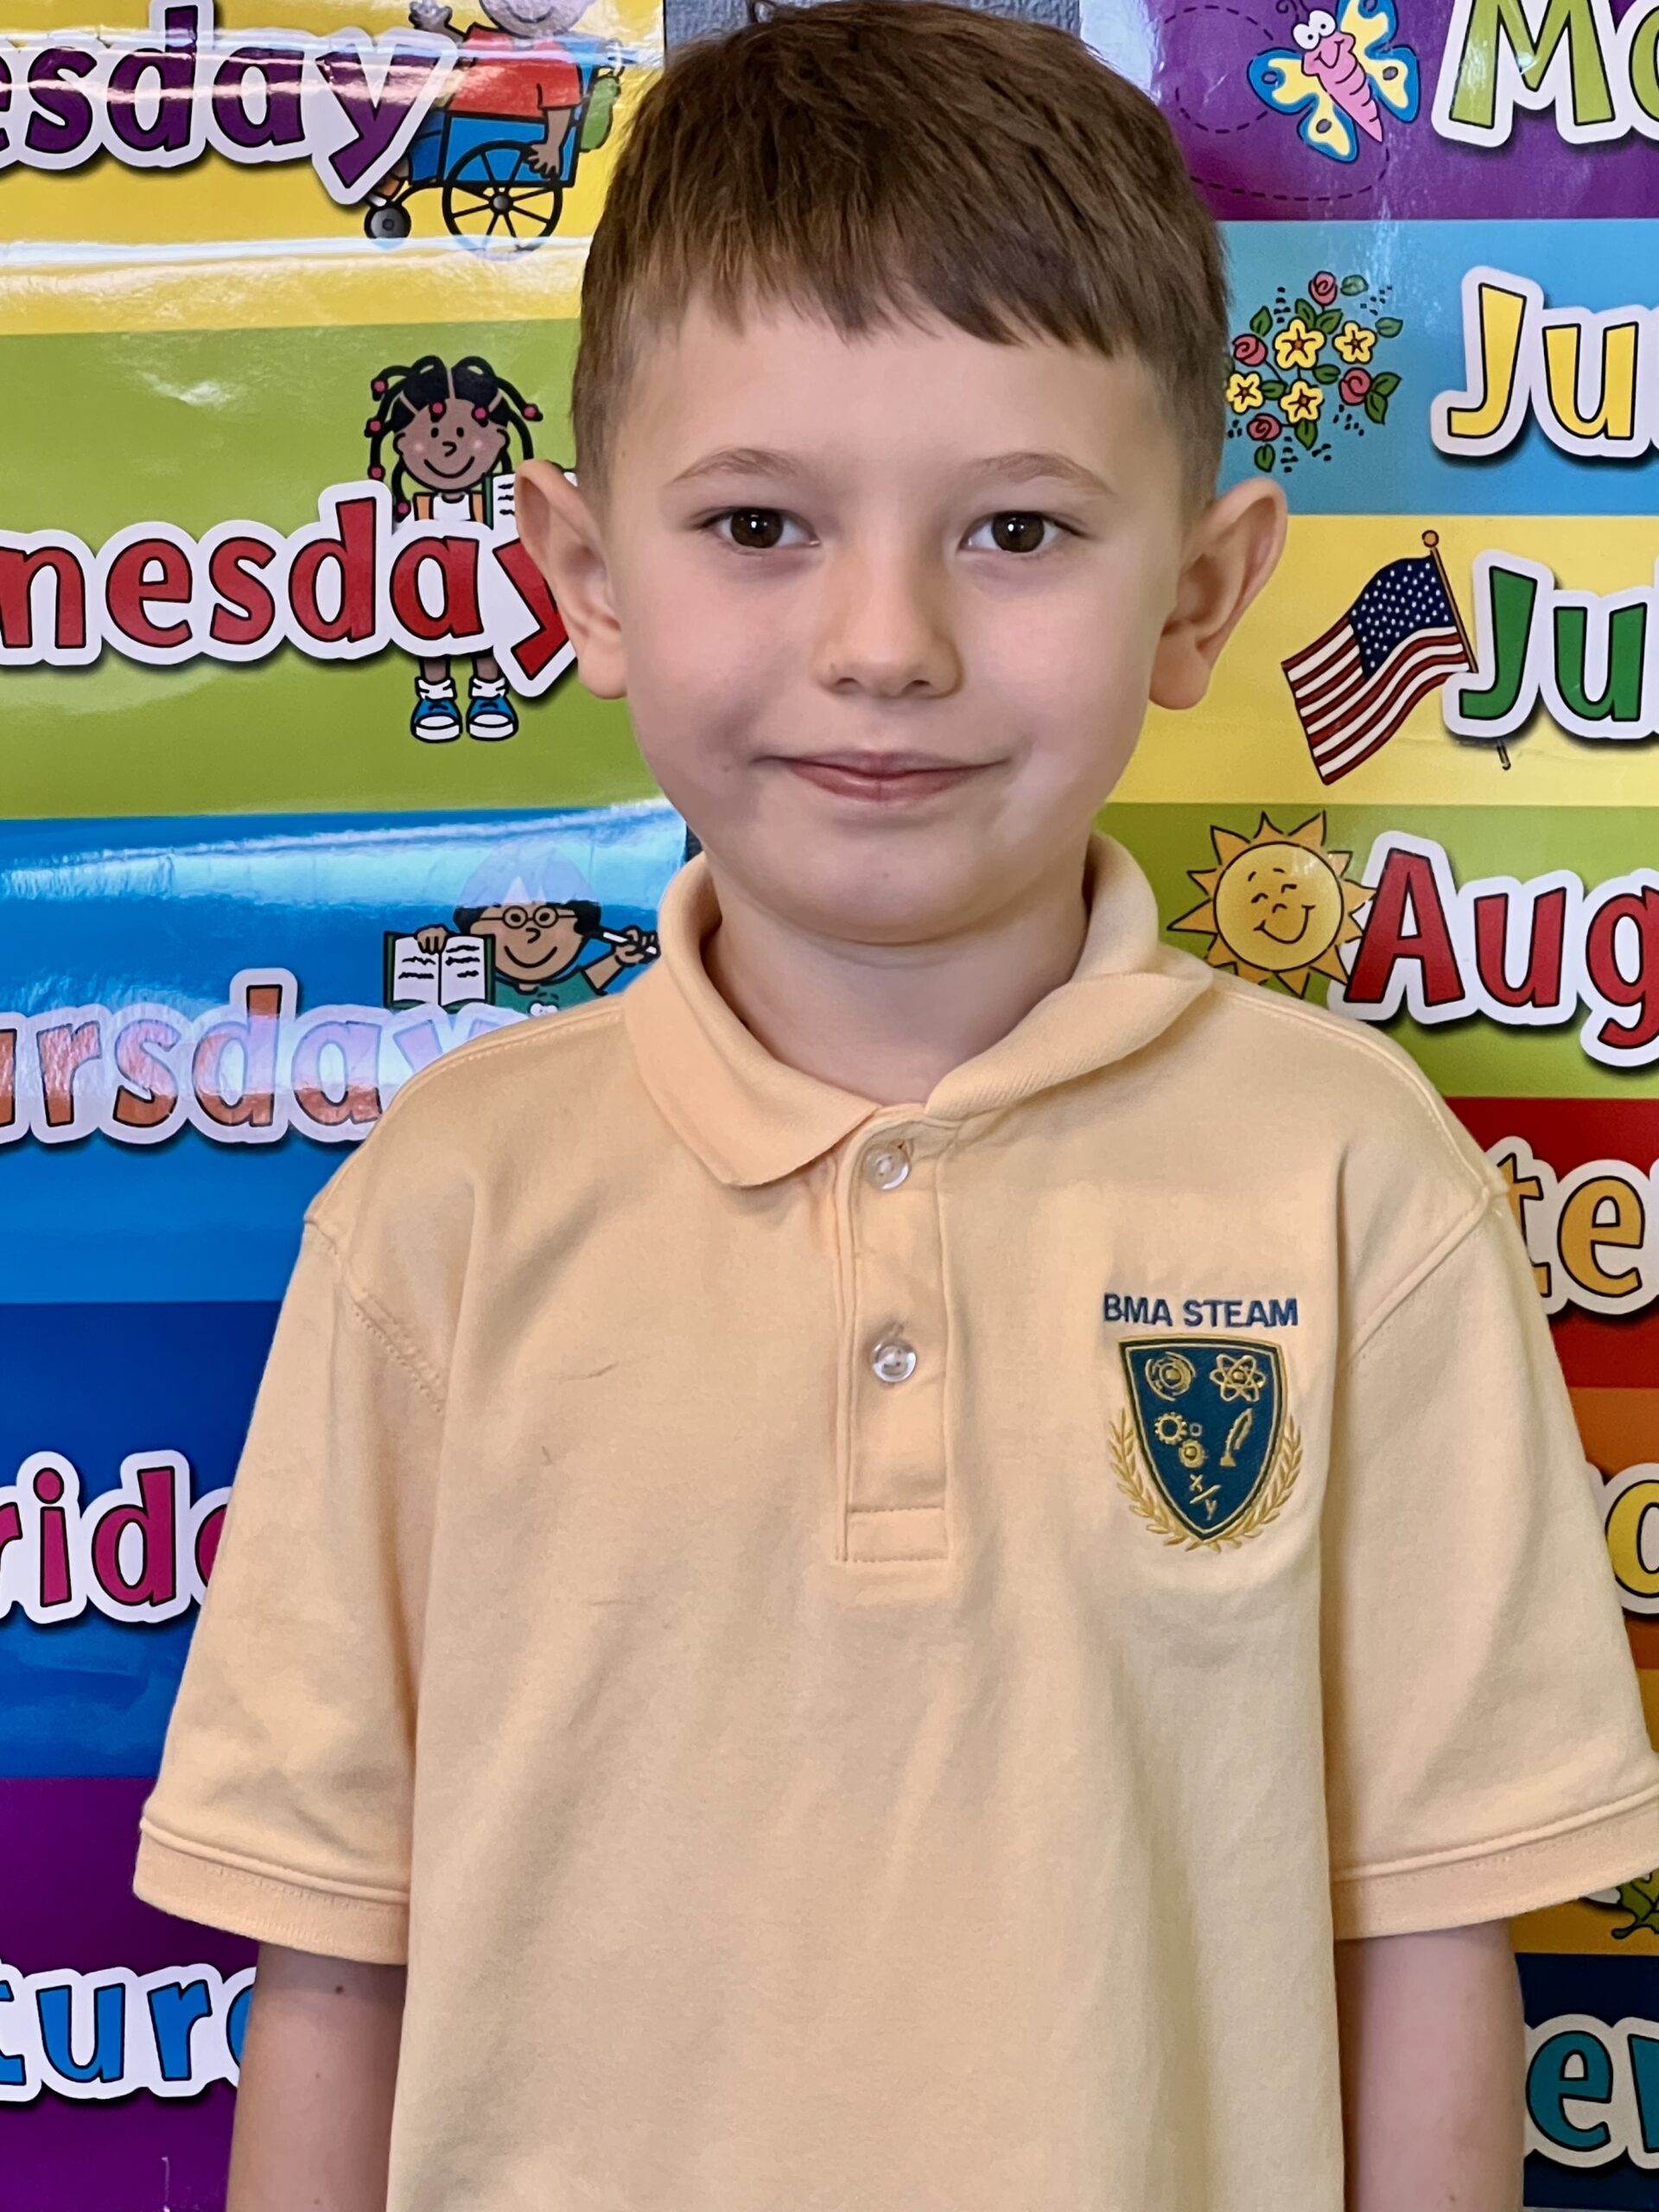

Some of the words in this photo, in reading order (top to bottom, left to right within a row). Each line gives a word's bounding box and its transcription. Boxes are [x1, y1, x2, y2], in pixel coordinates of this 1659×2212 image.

[0, 6, 441, 188] sday
[1446, 283, 1638, 441] Ju
[1459, 565, 1647, 721] Ju
[1343, 847, 1659, 1049] Aug
[1103, 1294, 1173, 1326] BMA
[1183, 1298, 1298, 1327] STEAM
